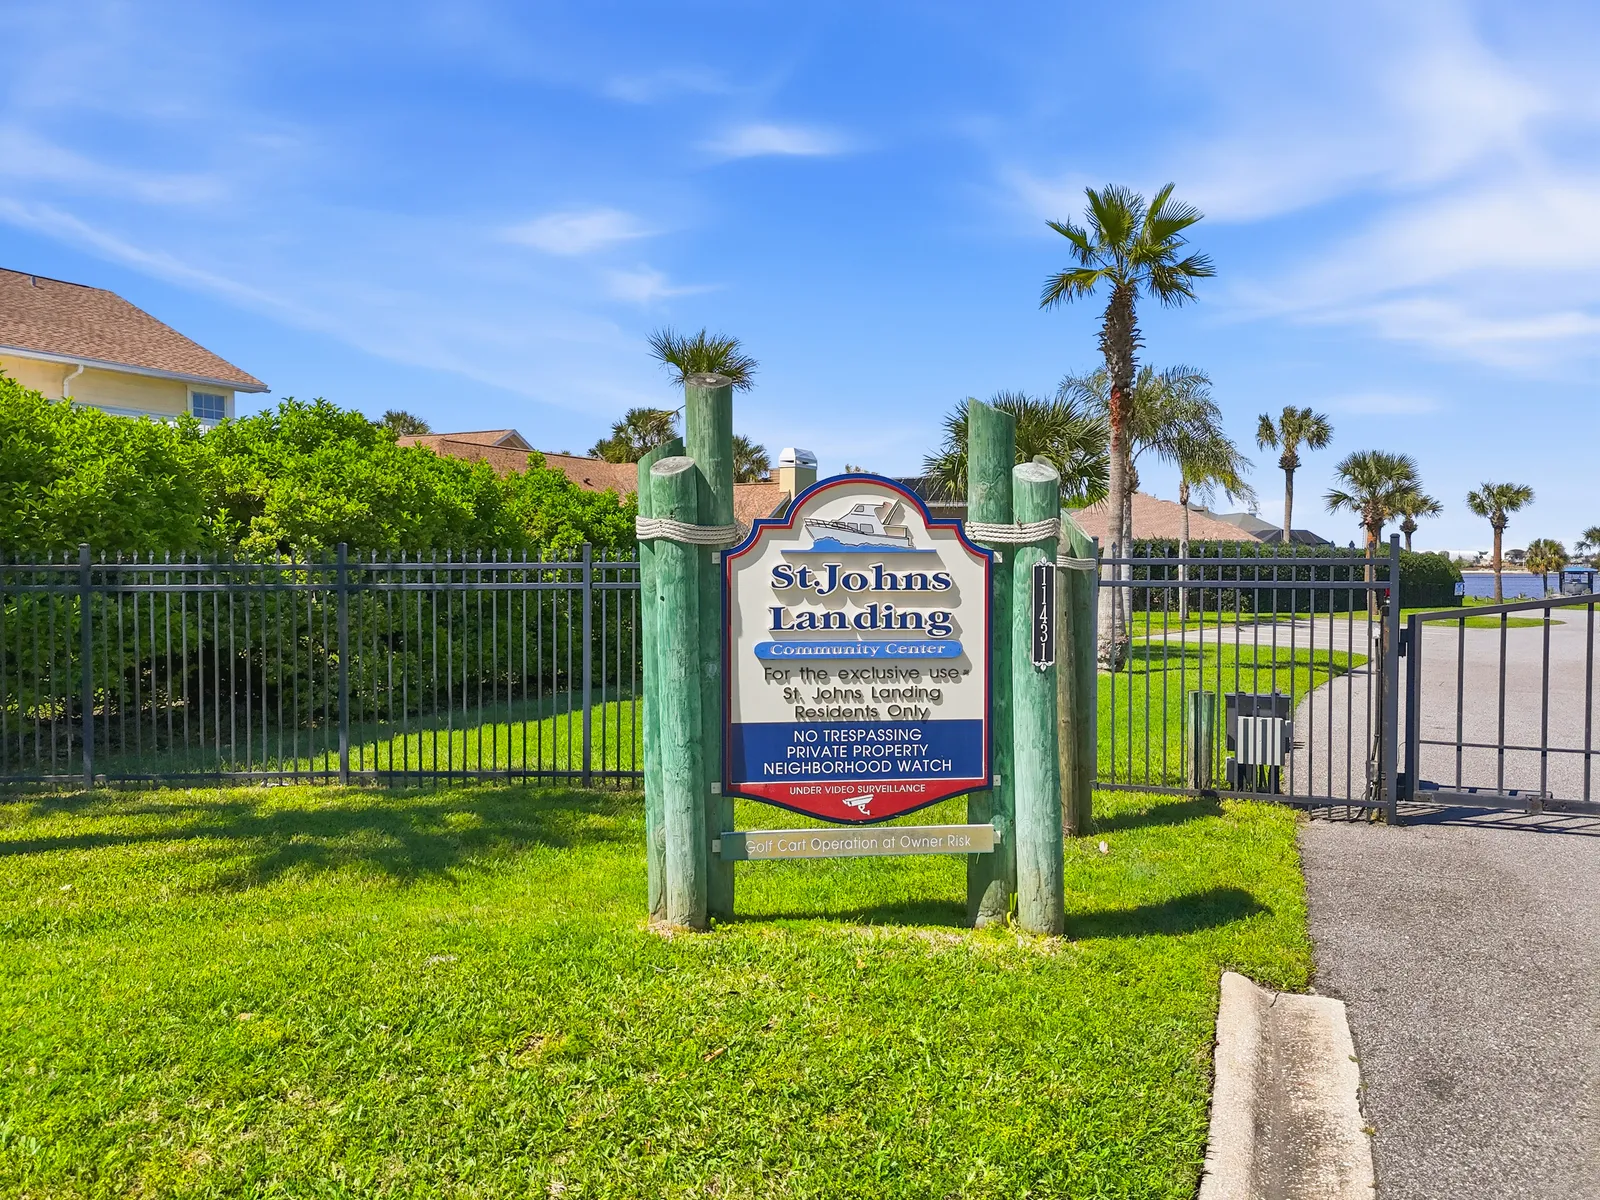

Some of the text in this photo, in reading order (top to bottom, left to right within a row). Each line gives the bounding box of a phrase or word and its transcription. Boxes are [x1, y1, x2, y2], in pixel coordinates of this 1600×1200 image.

[769, 603, 952, 637] Landing
[1039, 566, 1048, 662] 11431
[770, 643, 946, 656] Community Center
[764, 666, 959, 680] For the exclusive use
[783, 685, 941, 701] St. Johns Landing
[795, 704, 929, 719] Residents Only
[793, 728, 922, 743] NO TRESPASSING
[787, 744, 928, 759] PRIVATE PROPERTY
[763, 759, 952, 775] NEIGHBORHOOD WATCH
[789, 783, 926, 795] UNDER VIDEO SURVEILLANCE
[745, 834, 971, 855] Golf Cart Operation at Owner Risk
